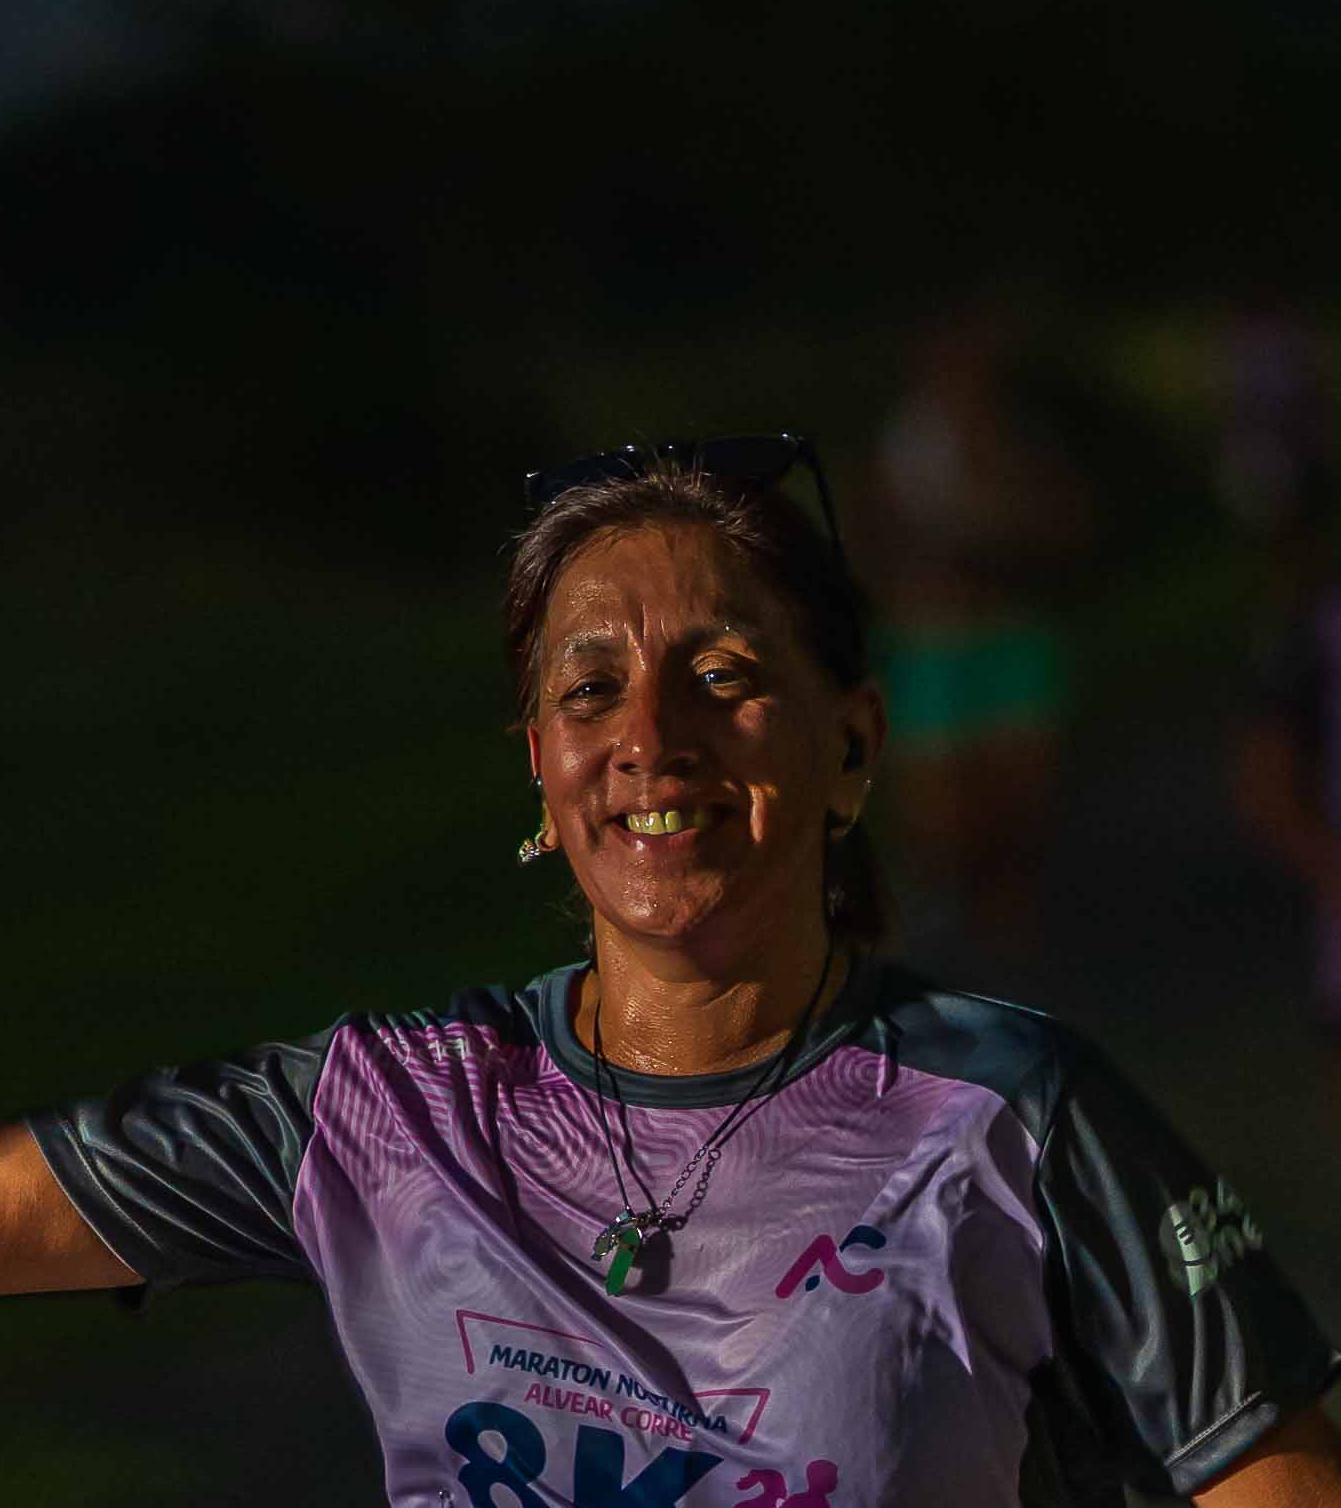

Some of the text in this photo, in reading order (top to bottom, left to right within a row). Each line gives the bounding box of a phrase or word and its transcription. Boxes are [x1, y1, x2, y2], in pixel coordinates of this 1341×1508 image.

[488, 1343, 611, 1391] MARATON
[523, 1382, 694, 1443] ALVEAR CORRE
